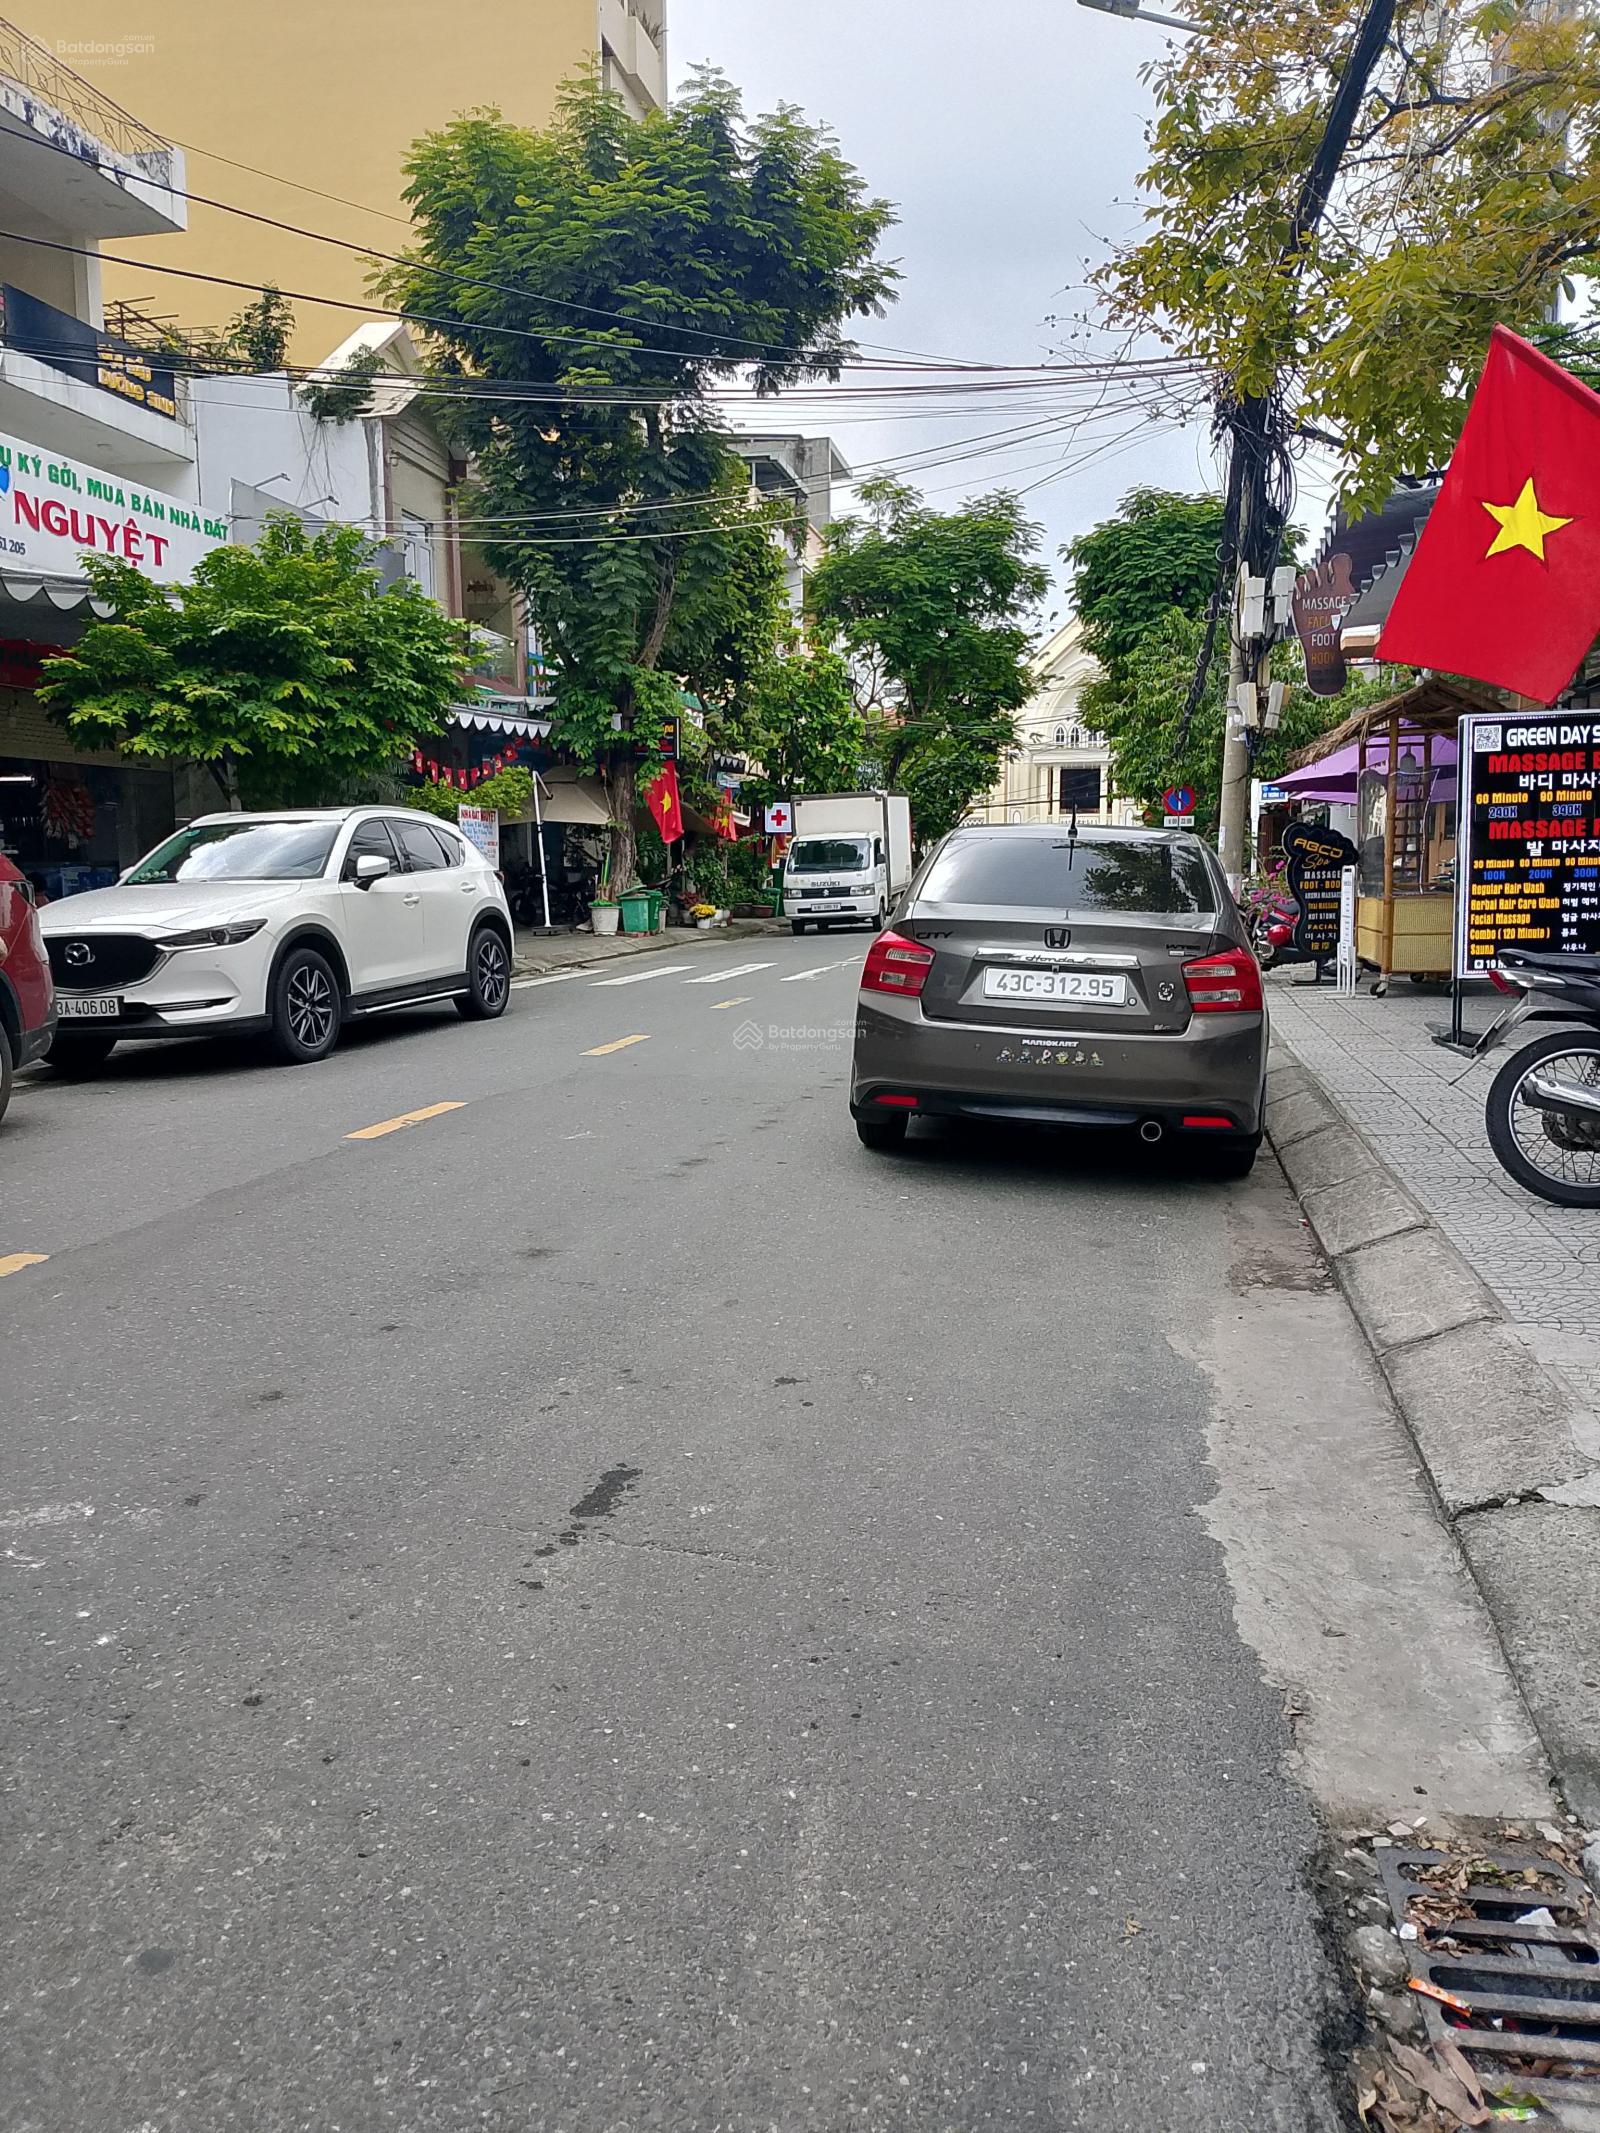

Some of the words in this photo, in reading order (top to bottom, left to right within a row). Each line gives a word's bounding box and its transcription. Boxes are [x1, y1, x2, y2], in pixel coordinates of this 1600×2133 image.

[17, 451, 41, 478] KÝ
[87, 477, 125, 508] MUA
[130, 493, 165, 520] BÁN
[169, 506, 201, 533] NHÀ
[203, 517, 229, 541] ĐẤT
[14, 489, 169, 567] NGUYỆT
[9, 539, 26, 556] 205
[1302, 596, 1347, 610] MASSAGE
[1311, 633, 1336, 647] FOOT
[1506, 726, 1557, 747] GREEN
[1560, 725, 1591, 745] DAY
[1488, 751, 1586, 774] MASSAGE
[1519, 773, 1553, 791] 바디
[1562, 771, 1600, 789] 마사
[1475, 793, 1489, 804] 60
[1492, 792, 1529, 804] Minute
[1556, 790, 1592, 801] Minute
[1488, 806, 1517, 819] 240K
[1552, 804, 1582, 816] 340K
[1488, 818, 1586, 839] MASSAGE
[1293, 838, 1343, 858] ABCD
[1526, 840, 1544, 856] 발
[1301, 854, 1329, 869] Spa
[1304, 870, 1341, 879] MASSAGE
[1528, 869, 1552, 879] 200K
[1573, 867, 1598, 878] 300K
[1300, 880, 1319, 889] FOOT
[1325, 880, 1341, 889] BOD
[1472, 883, 1503, 895] Regular
[1504, 883, 1522, 894] Hair
[1523, 882, 1545, 894] Wash
[1471, 899, 1497, 910] Herbal
[1499, 898, 1516, 910] Hair
[1518, 897, 1537, 909] Care
[1538, 896, 1560, 908] Wash
[1320, 912, 1336, 920] STONE
[1470, 913, 1494, 925] Facial
[1495, 913, 1531, 924] Massage
[916, 931, 953, 939] CITY
[1470, 928, 1496, 940] Combo
[1470, 944, 1494, 955] Sauna
[1561, 943, 1587, 951] 사우나
[1025, 955, 1075, 963] Honda
[996, 973, 1114, 998] 43C-312.95
